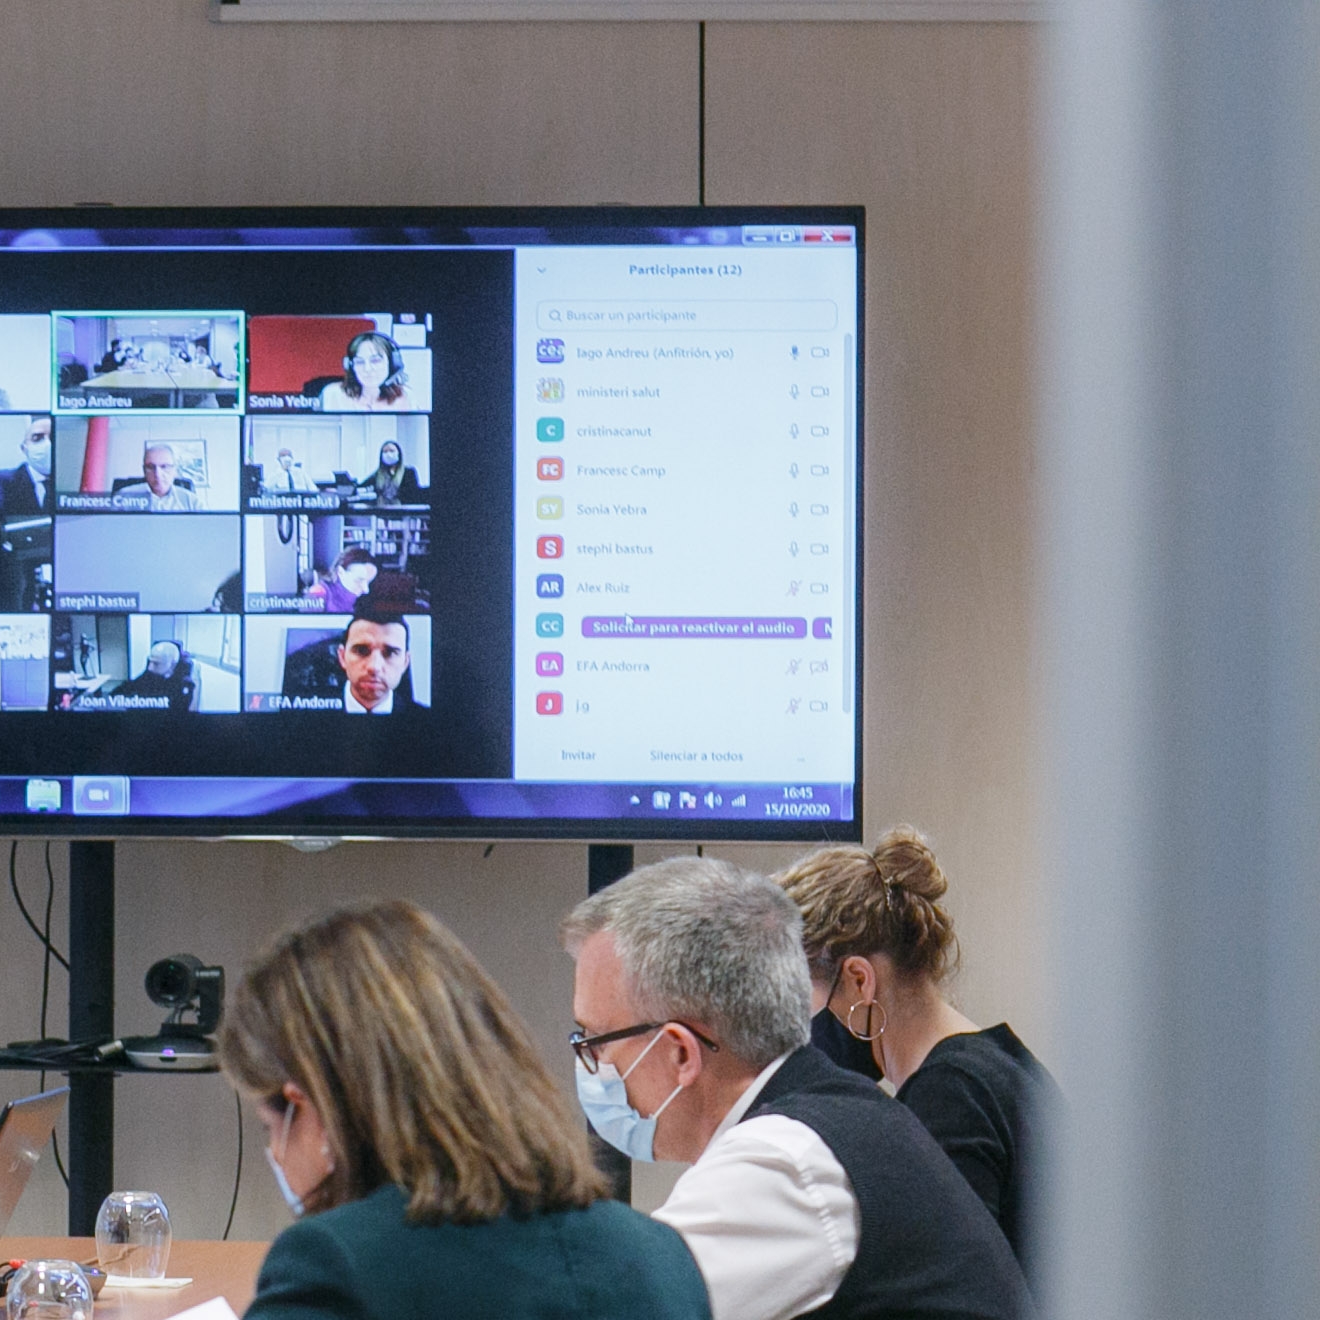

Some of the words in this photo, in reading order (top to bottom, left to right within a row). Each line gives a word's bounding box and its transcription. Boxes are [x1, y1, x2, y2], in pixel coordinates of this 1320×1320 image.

[629, 264, 714, 277] Participantes
[717, 264, 743, 277] (12)
[566, 310, 605, 321] Buscar
[609, 312, 624, 321] un
[627, 309, 697, 324] participante
[576, 348, 603, 361] Iago
[606, 347, 649, 359] Andreu
[714, 347, 735, 361] yo)
[576, 386, 628, 399] ministeri
[632, 385, 661, 398] salut
[60, 395, 86, 409] Iago
[88, 394, 133, 408] Andreu
[249, 395, 284, 409] Sonia
[286, 394, 321, 409] Yebra
[576, 425, 653, 437] cristinacanut
[576, 465, 628, 477] Francesc
[631, 464, 667, 479] Camp
[60, 495, 111, 508] Francesc
[112, 495, 149, 509] Camp
[249, 494, 302, 509] ministeri
[576, 503, 610, 516] Sonia
[613, 503, 648, 516] Yebra
[576, 542, 612, 557] stephi
[615, 542, 654, 555] bastus
[576, 582, 601, 594] Alex
[605, 582, 630, 594] Ruiz
[60, 594, 96, 610] stephi
[97, 594, 137, 608] bastus
[249, 595, 325, 609] cristinacanut
[649, 622, 680, 636] para
[681, 620, 739, 634] reactivar
[741, 620, 755, 634] el
[757, 620, 796, 634] audio
[576, 660, 599, 672] EFA
[601, 660, 650, 672] Andorra
[78, 694, 106, 708] Joan
[108, 693, 169, 709] Viladomat
[268, 695, 292, 709] EFA
[293, 694, 343, 709] Andorra
[561, 749, 597, 761] Invitar
[650, 750, 697, 762] Silenciar
[711, 750, 744, 762] todos
[783, 786, 814, 800] 16:45
[764, 802, 831, 817] 15/10/2020
